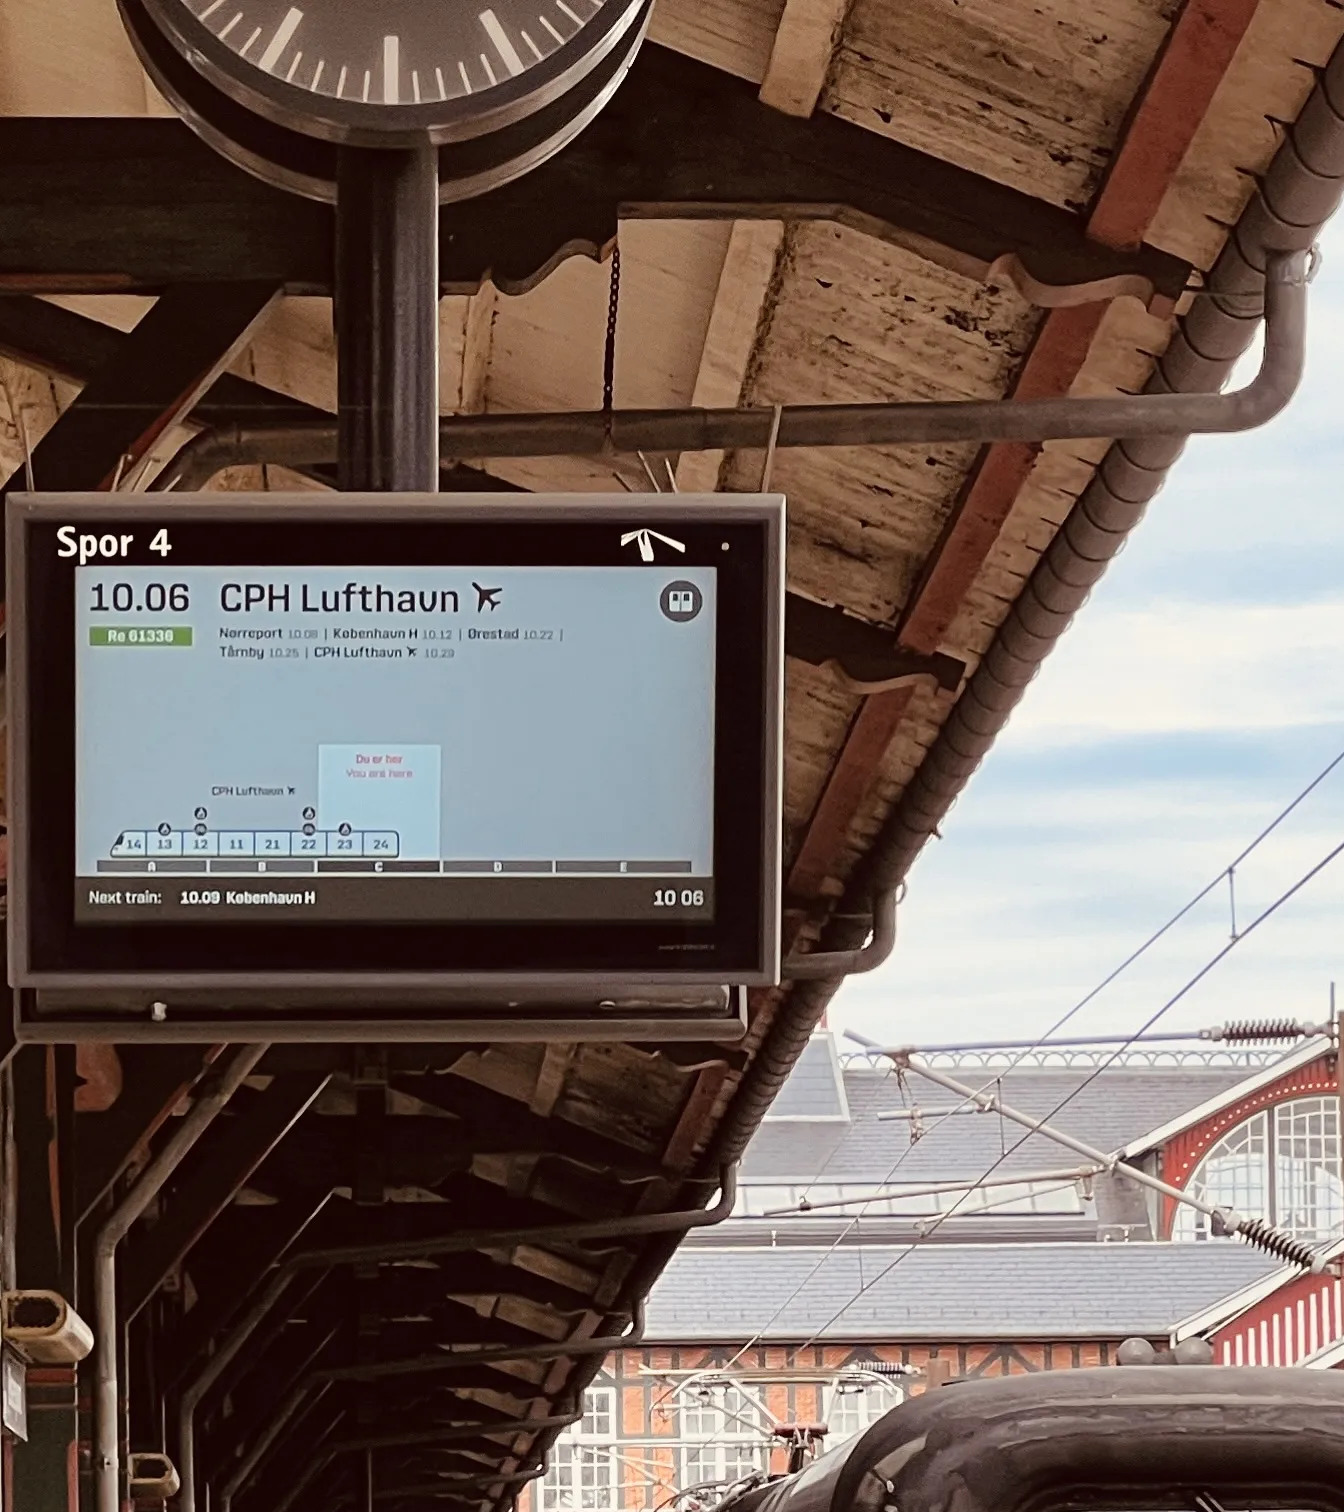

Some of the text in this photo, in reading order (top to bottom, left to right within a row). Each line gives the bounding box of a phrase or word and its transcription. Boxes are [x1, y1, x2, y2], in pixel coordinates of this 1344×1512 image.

[57, 526, 172, 565] Spor 4
[90, 583, 189, 611] 10.06
[220, 582, 459, 612] CPH Lufthavn
[219, 627, 283, 641] Nørreport
[333, 627, 405, 640] København
[409, 628, 418, 639] H
[468, 628, 519, 640] Ørestad
[219, 645, 264, 660] Tårnby
[314, 646, 340, 658] CPH
[344, 646, 402, 658] Lufthavn
[212, 785, 283, 796] CPH Lufthavn
[126, 840, 389, 850] 14 13 12 11 21 22 23 24
[89, 890, 122, 905] Next
[125, 890, 162, 905] train:
[226, 889, 302, 905] København
[305, 890, 316, 905] H
